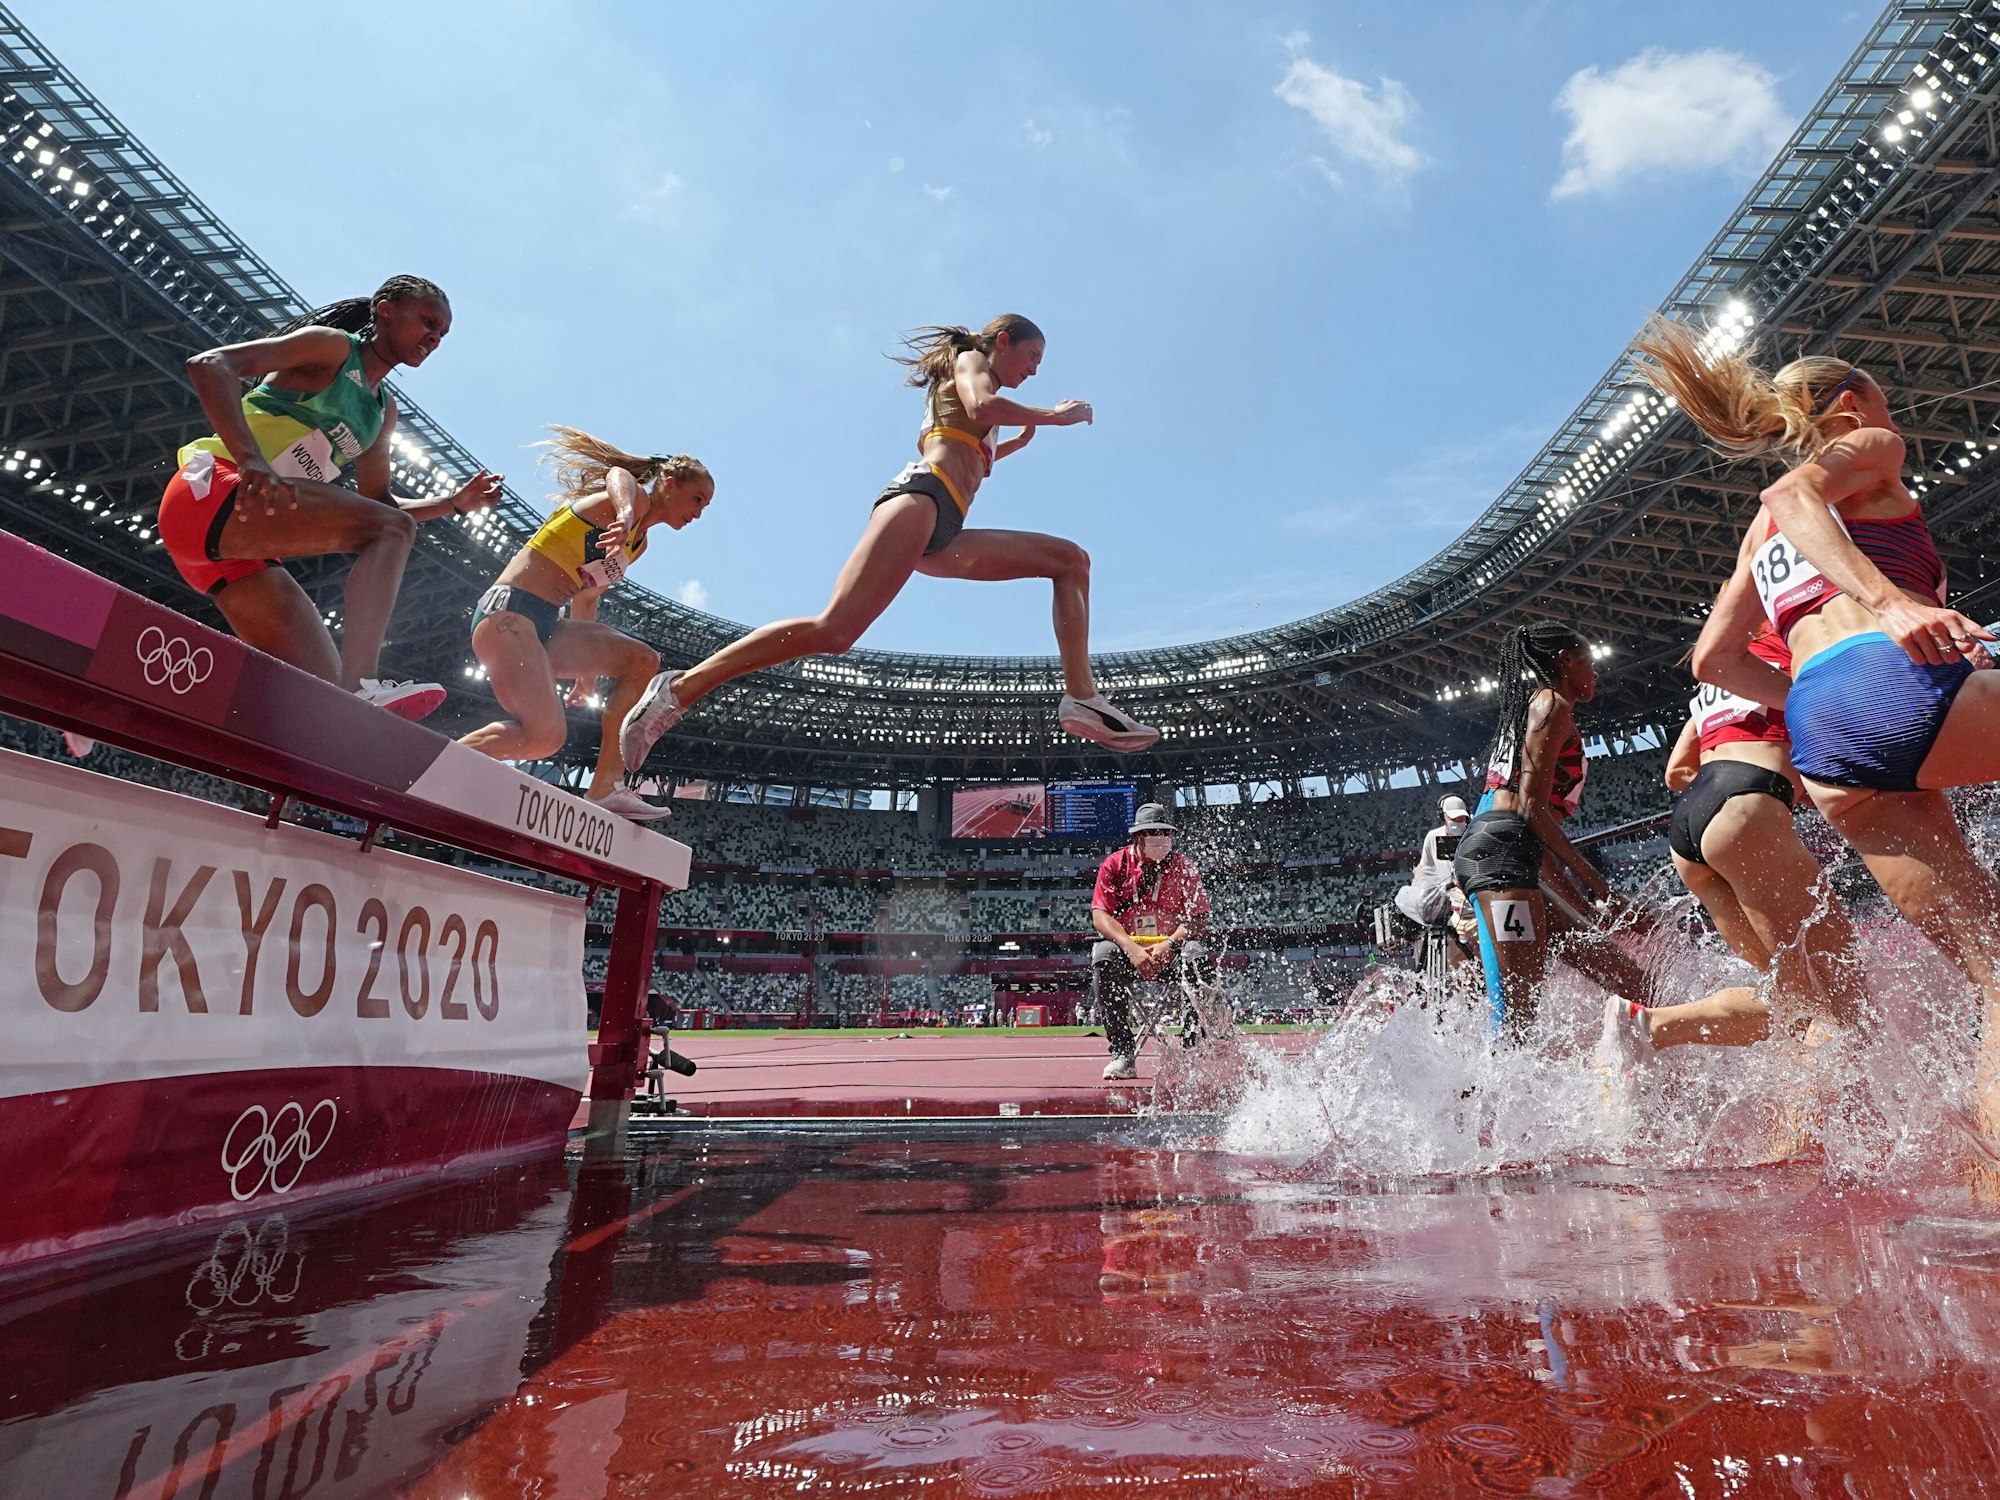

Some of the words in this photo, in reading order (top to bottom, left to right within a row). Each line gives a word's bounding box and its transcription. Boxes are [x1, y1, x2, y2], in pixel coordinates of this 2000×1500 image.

[516, 784, 575, 843] TOKYO
[575, 811, 614, 858] 2020
[1278, 925, 1305, 935] TOKYO
[1306, 924, 1327, 934] 2020
[1503, 904, 1525, 937] 4
[775, 931, 802, 941] TOKYO
[944, 934, 971, 943] TOKYO
[972, 934, 992, 943] 2020
[356, 897, 500, 1021] 2020
